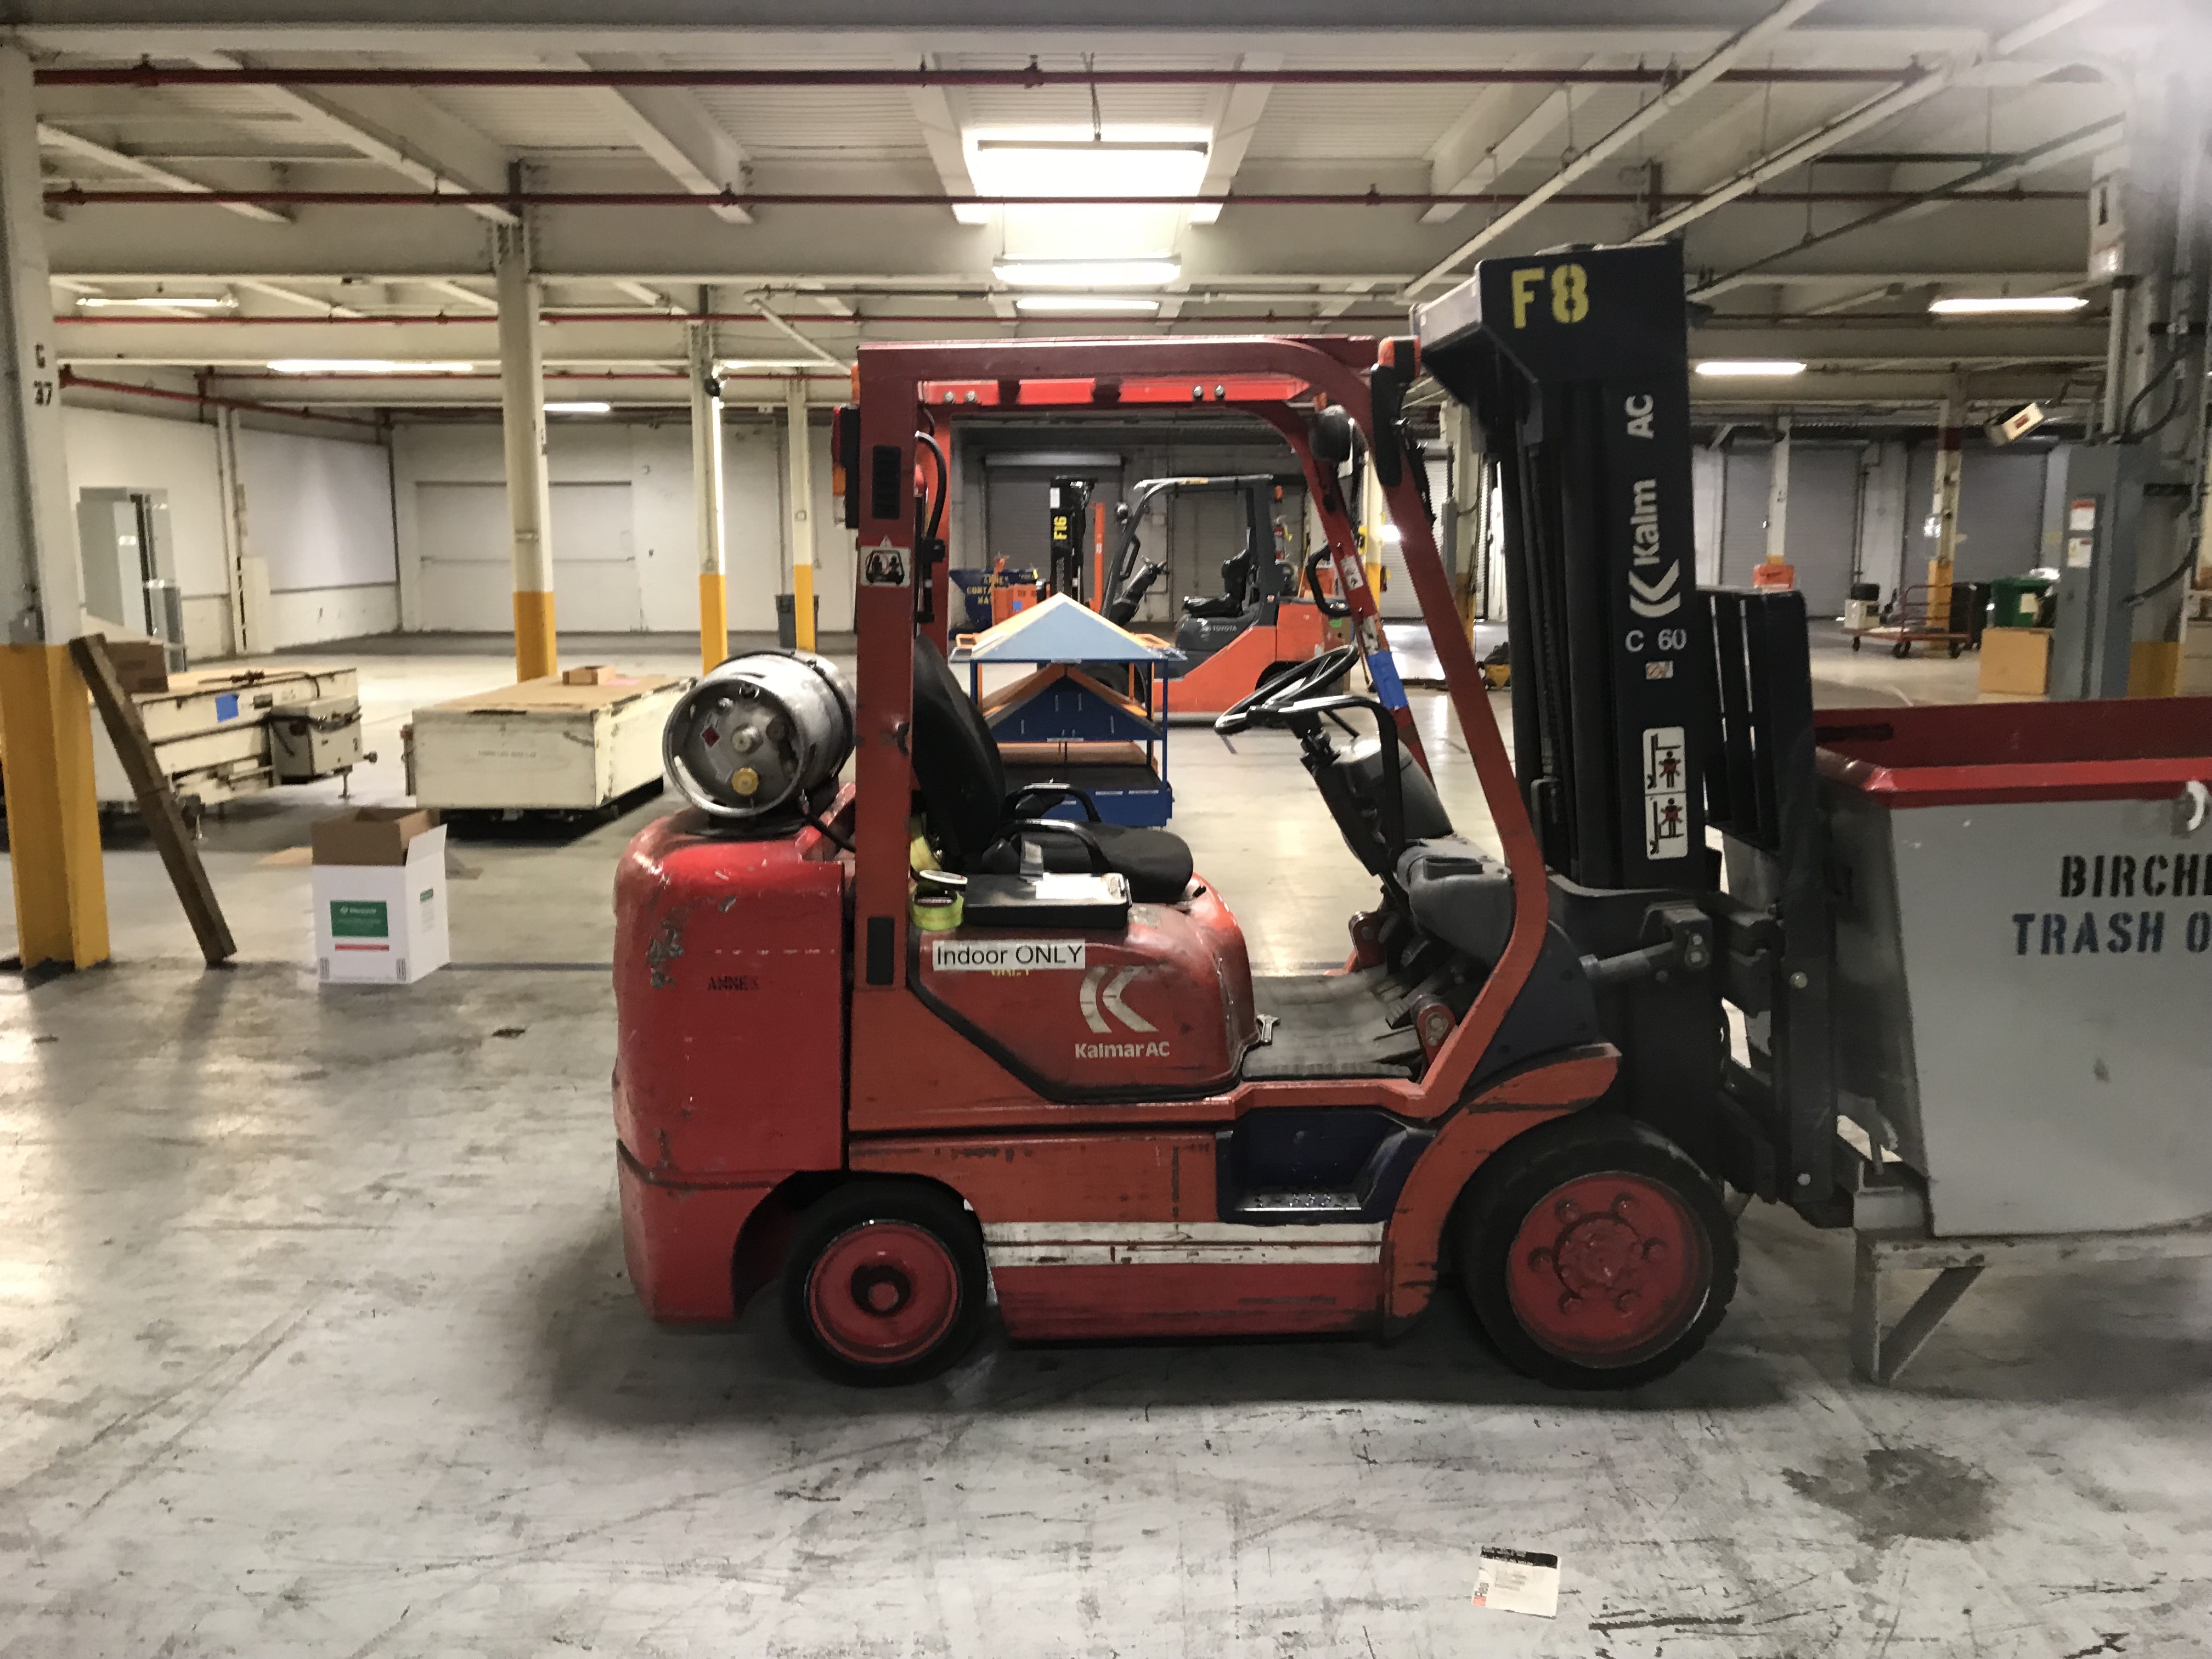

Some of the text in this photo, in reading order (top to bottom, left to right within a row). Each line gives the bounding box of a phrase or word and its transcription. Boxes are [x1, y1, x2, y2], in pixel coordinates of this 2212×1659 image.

[1511, 263, 1589, 329] F8
[1626, 394, 1654, 438] AC
[1053, 516, 1067, 540] F16
[1626, 629, 1686, 652] C 60
[2012, 911, 2165, 955] TRASH
[937, 945, 1082, 965] Indoor ONLY
